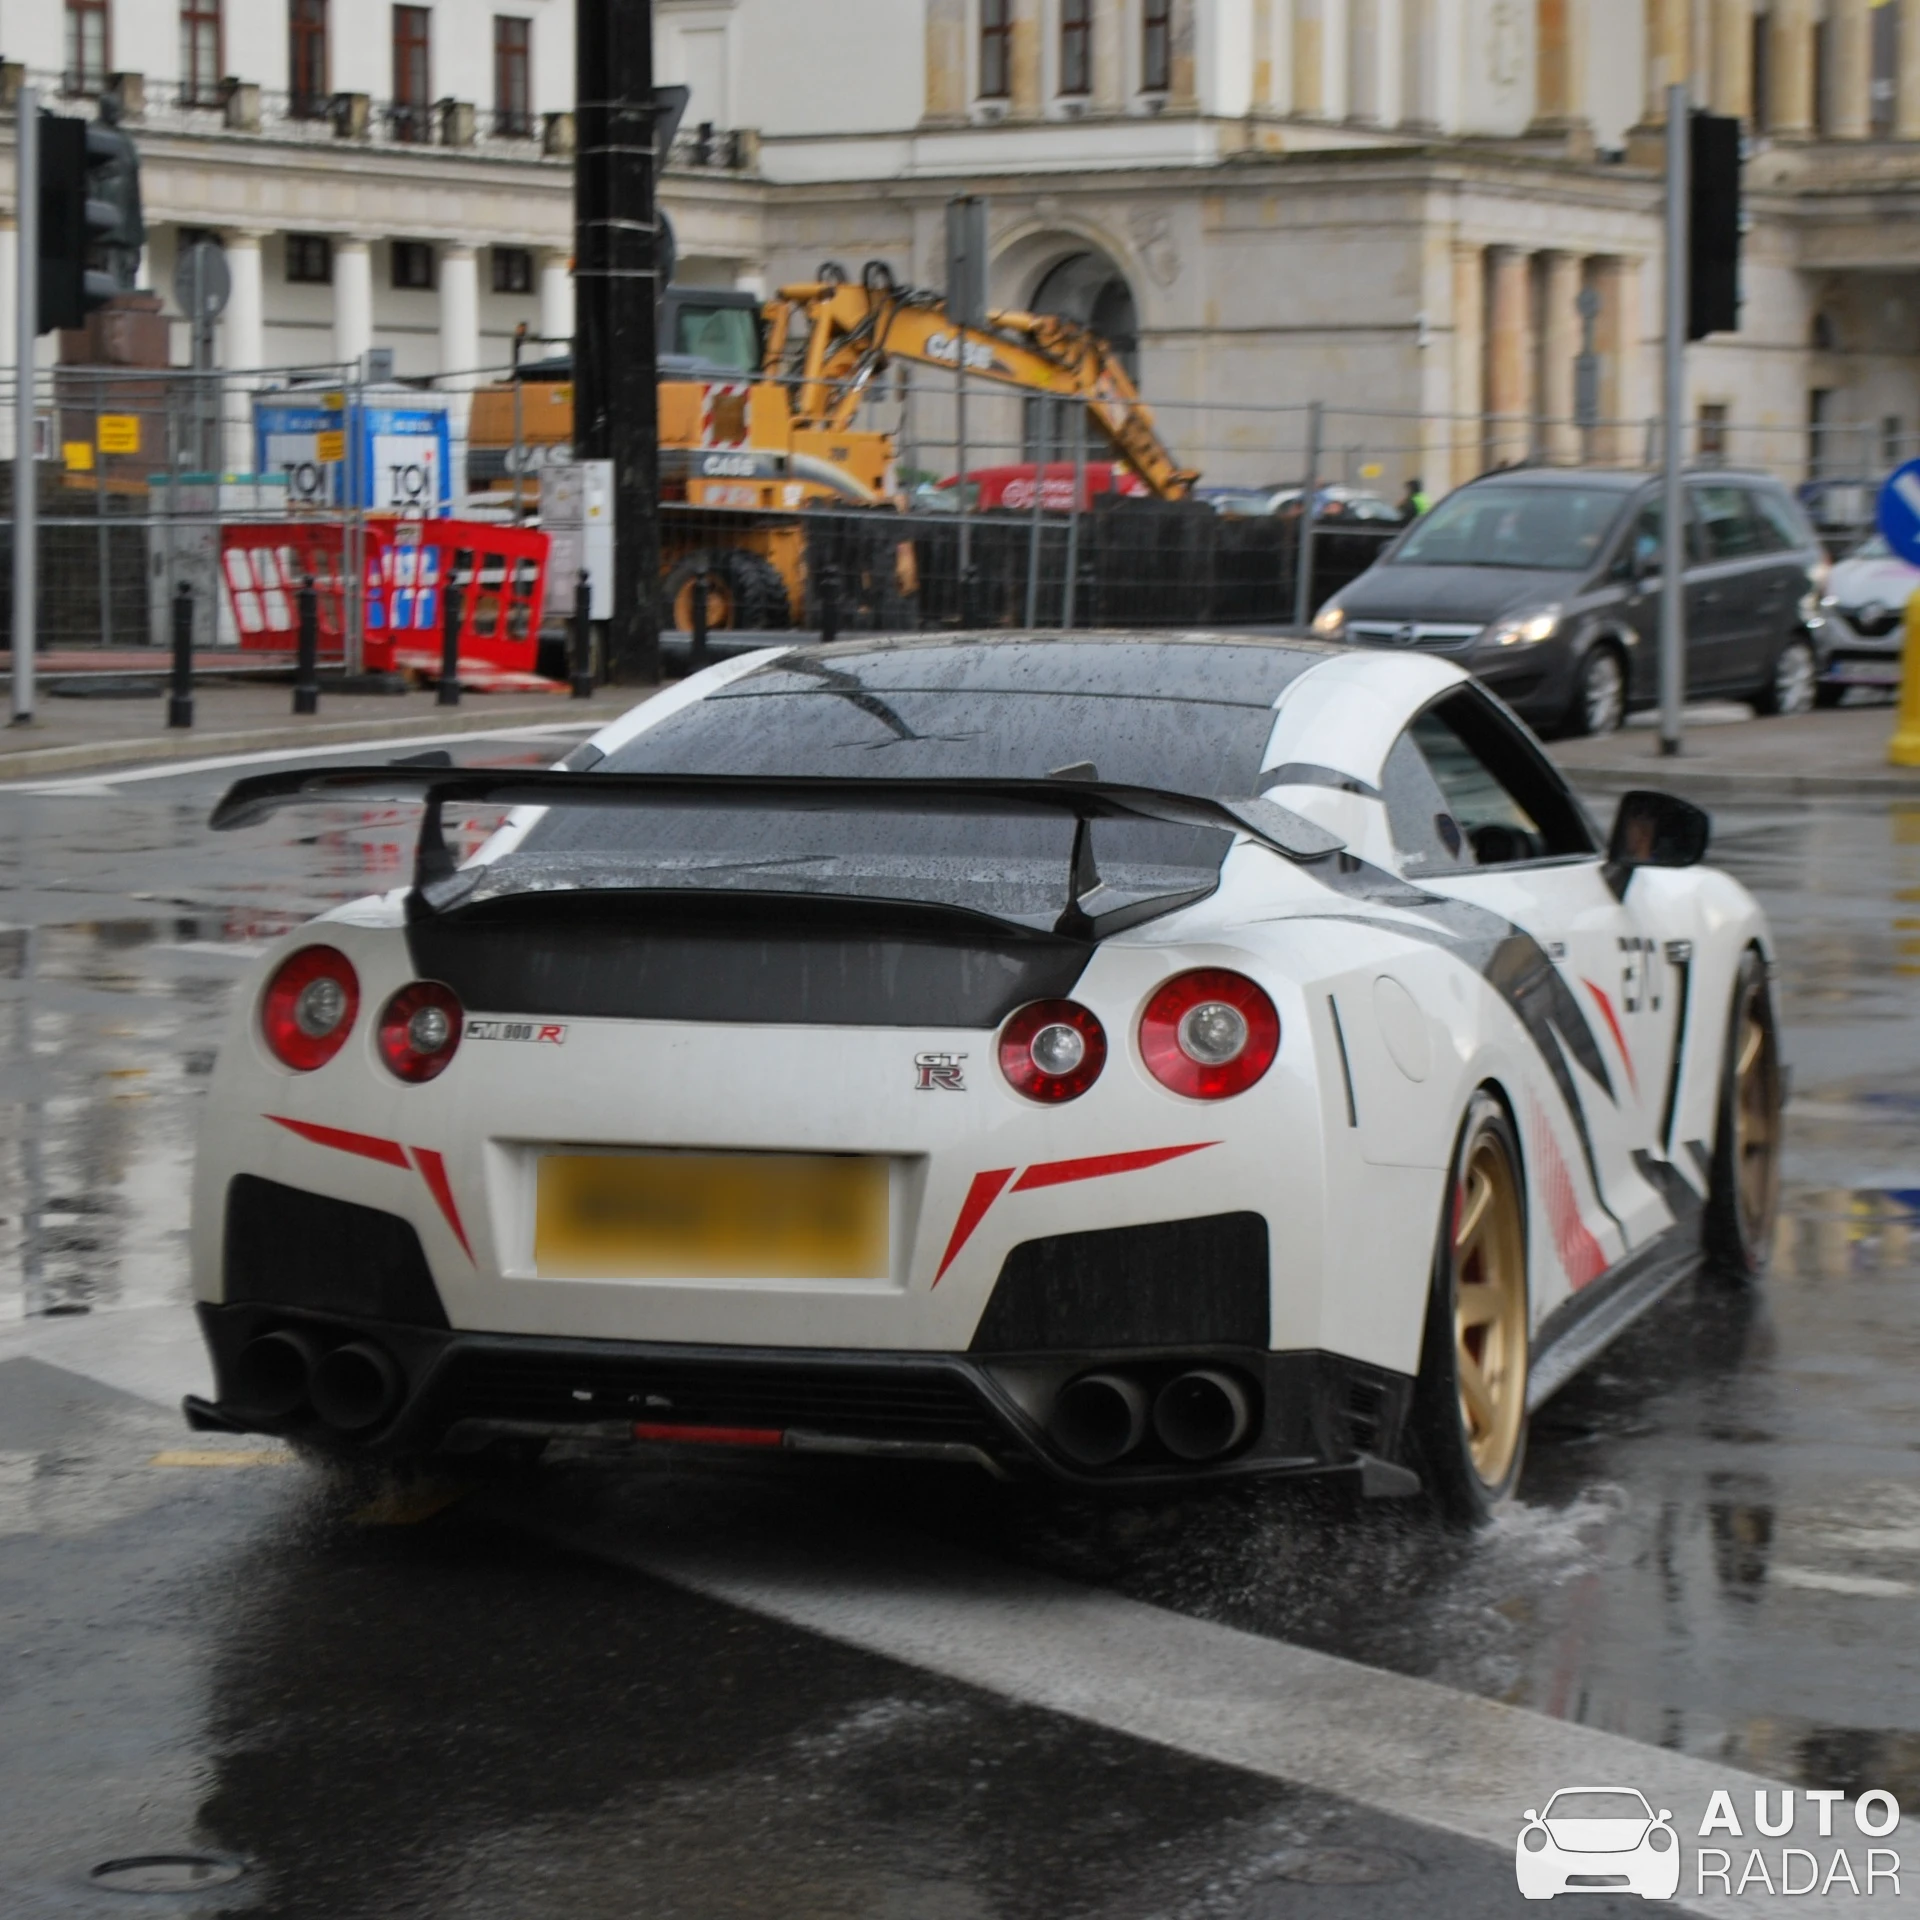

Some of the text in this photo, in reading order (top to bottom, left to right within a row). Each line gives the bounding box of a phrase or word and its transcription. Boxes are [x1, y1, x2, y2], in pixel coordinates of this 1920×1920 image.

[926, 333, 994, 370] CASE
[703, 454, 757, 477] CASE
[537, 1024, 564, 1046] R
